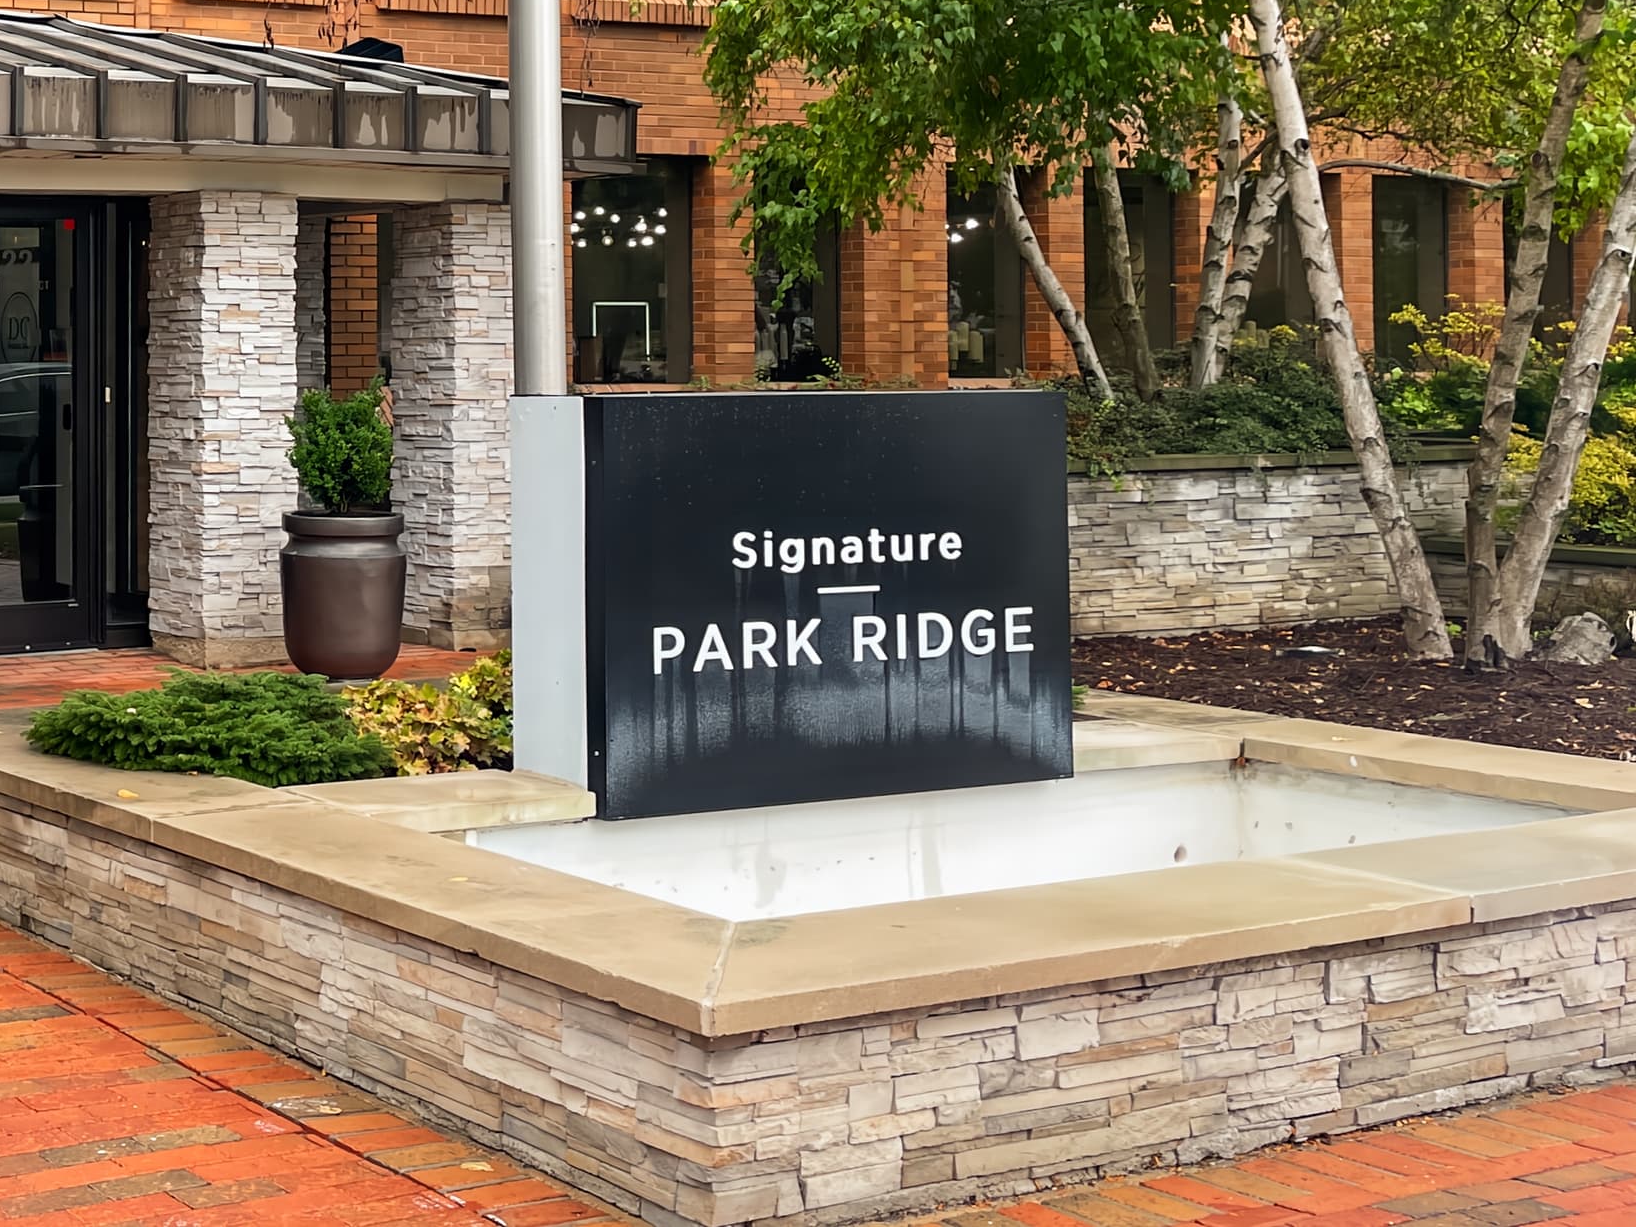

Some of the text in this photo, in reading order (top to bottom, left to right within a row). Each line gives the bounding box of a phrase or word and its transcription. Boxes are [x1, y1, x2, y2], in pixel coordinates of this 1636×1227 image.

[731, 528, 963, 574] Signature
[652, 606, 1035, 675] PARK RIDGE
